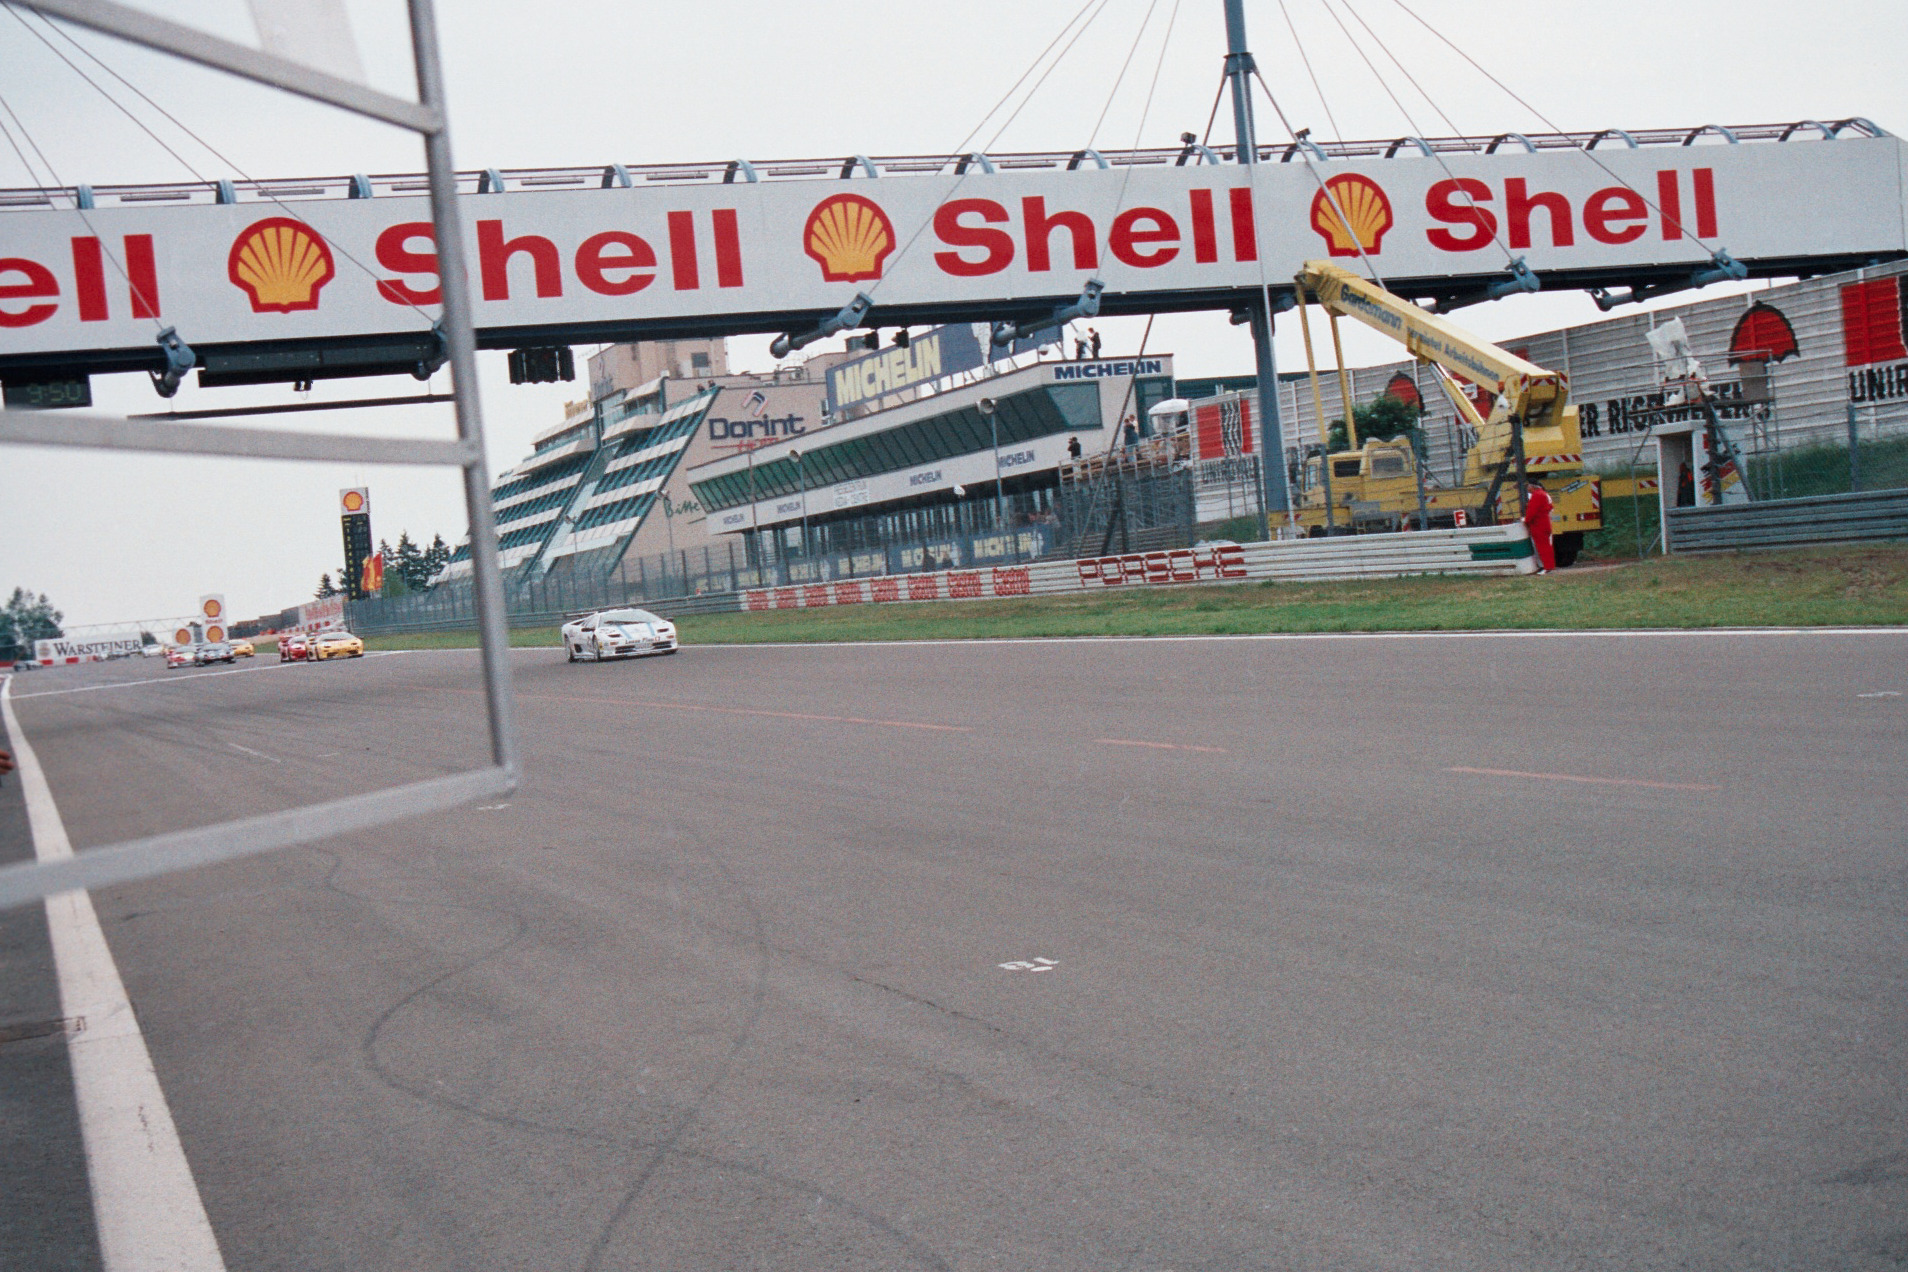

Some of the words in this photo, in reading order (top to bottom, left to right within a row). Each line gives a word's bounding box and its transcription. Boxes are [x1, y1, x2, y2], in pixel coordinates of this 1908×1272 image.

[1425, 167, 1718, 252] Shell
[933, 187, 1258, 277] Shell
[375, 208, 744, 306] Shell
[835, 334, 942, 407] MICHELIN
[1054, 360, 1162, 380] MICHELIN
[708, 412, 806, 441] Dorint
[909, 469, 943, 487] MICHELIN
[1076, 545, 1248, 588] PORSCHE
[53, 639, 142, 657] WARSTEINER
